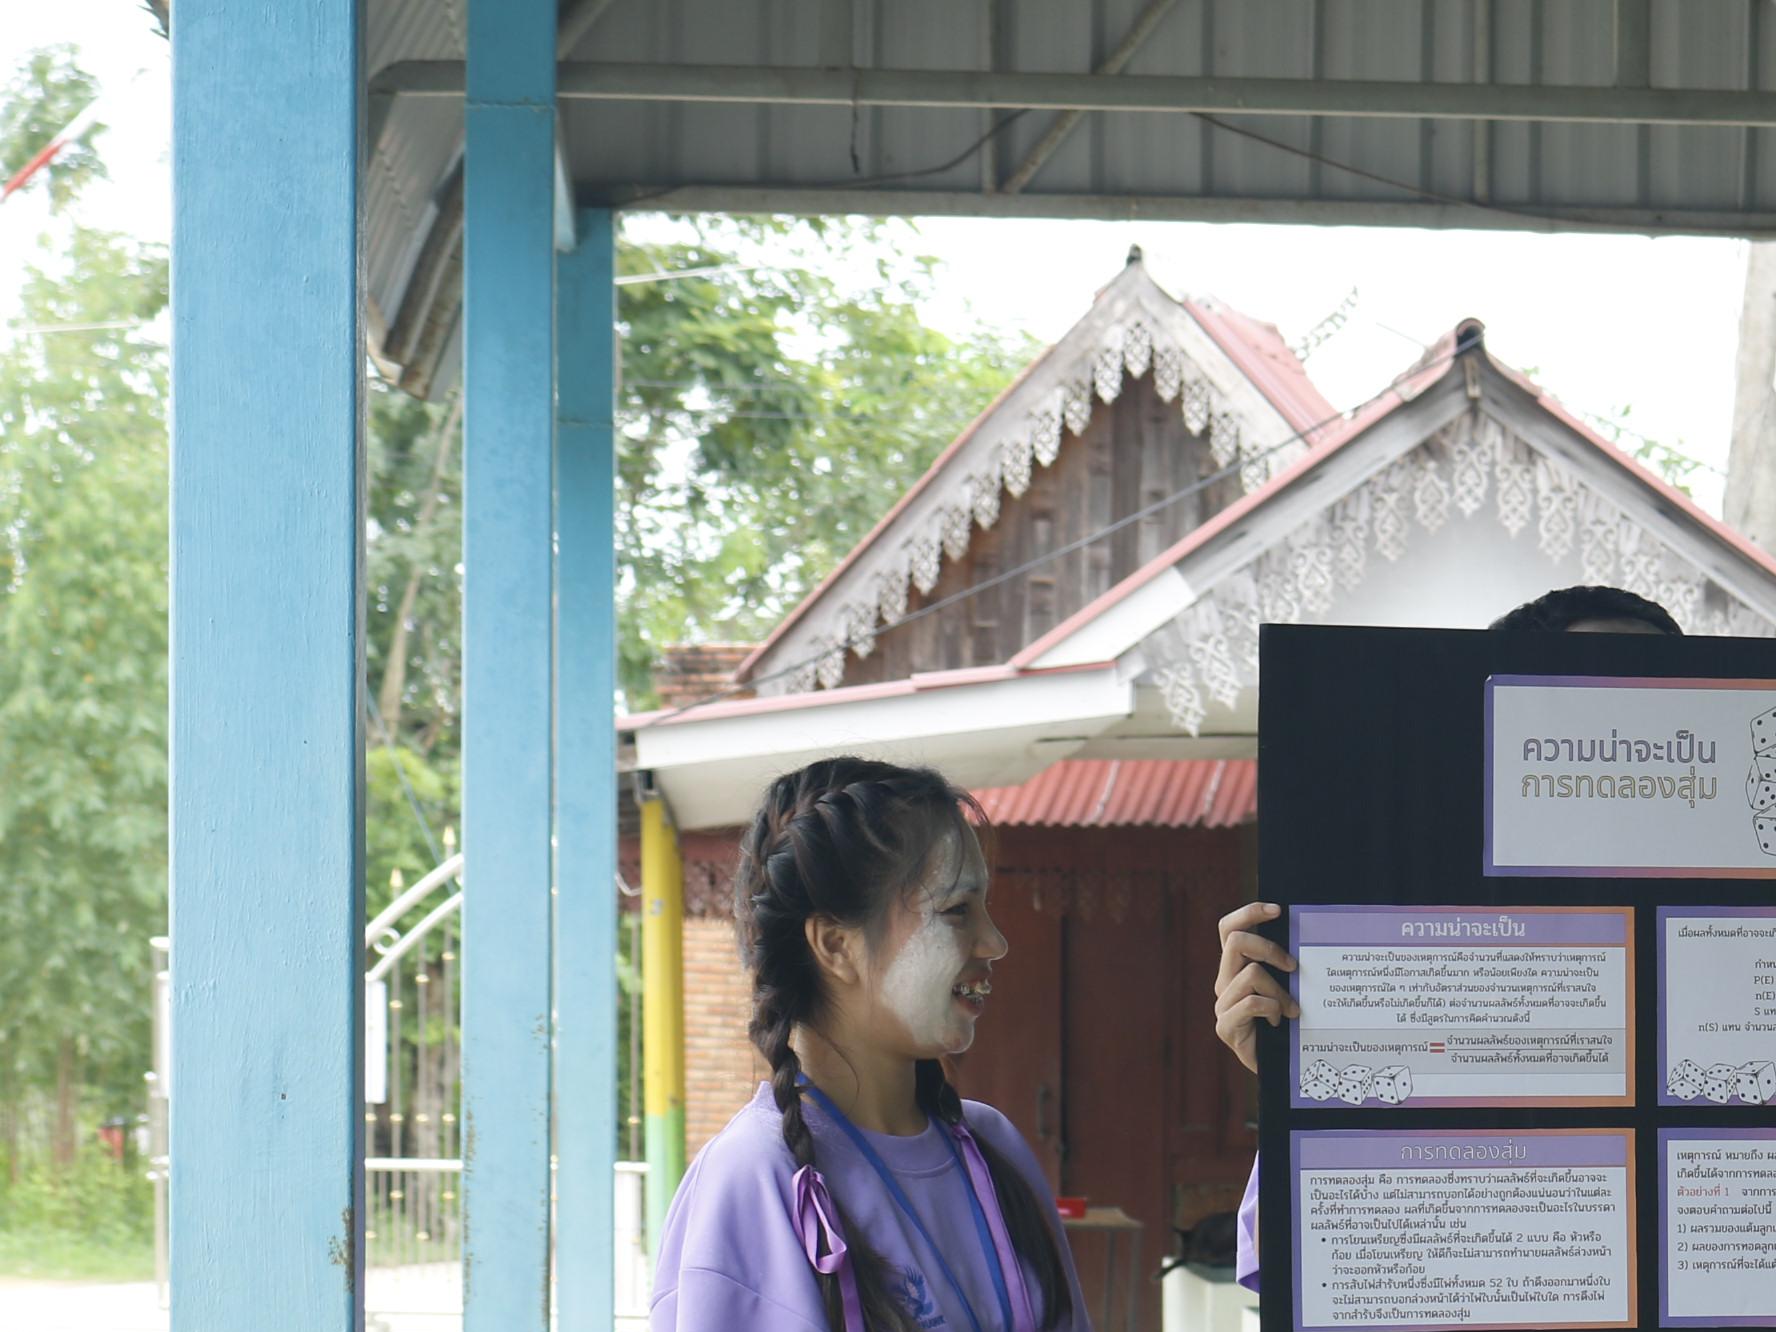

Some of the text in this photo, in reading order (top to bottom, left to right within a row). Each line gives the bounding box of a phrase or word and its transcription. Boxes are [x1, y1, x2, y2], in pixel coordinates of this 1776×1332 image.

[1524, 729, 1715, 767] ความน่าจะเป็น
[1522, 766, 1716, 808] การทดลองสุ่ม
[1402, 915, 1525, 936] ความน่าจะเป็น
[1473, 967, 1537, 977] หรือน้อยเพียงใด
[1541, 967, 1599, 977] ความน่าจะเป็น
[1754, 976, 1774, 984] P(E)
[1330, 982, 1396, 997] ของเหตุการณ์ใด
[1397, 1013, 1406, 1022] ได้
[1699, 1023, 1718, 1032] n(S)
[1400, 1139, 1527, 1164] การทดลองสุ่ม
[1677, 1149, 1721, 1163] เหตุการณ์
[1726, 1149, 1763, 1160] หมายถึง
[1311, 1175, 1374, 1188] การทดลองสุ่ม
[1379, 1174, 1392, 1184] คือ
[1311, 1189, 1379, 1204] เป็นอะไรได้บ้าง
[1678, 1186, 1720, 1196] ตัวอย่างที่
[1724, 1187, 1728, 1196] 1
[1517, 1233, 1523, 1242] 2
[1553, 1231, 1566, 1242] คือ
[1571, 1231, 1601, 1242] หัวหรือ
[1678, 1260, 1688, 1270] 3)
[1490, 1278, 1502, 1292] 52
[1506, 1277, 1518, 1287] ใบ
